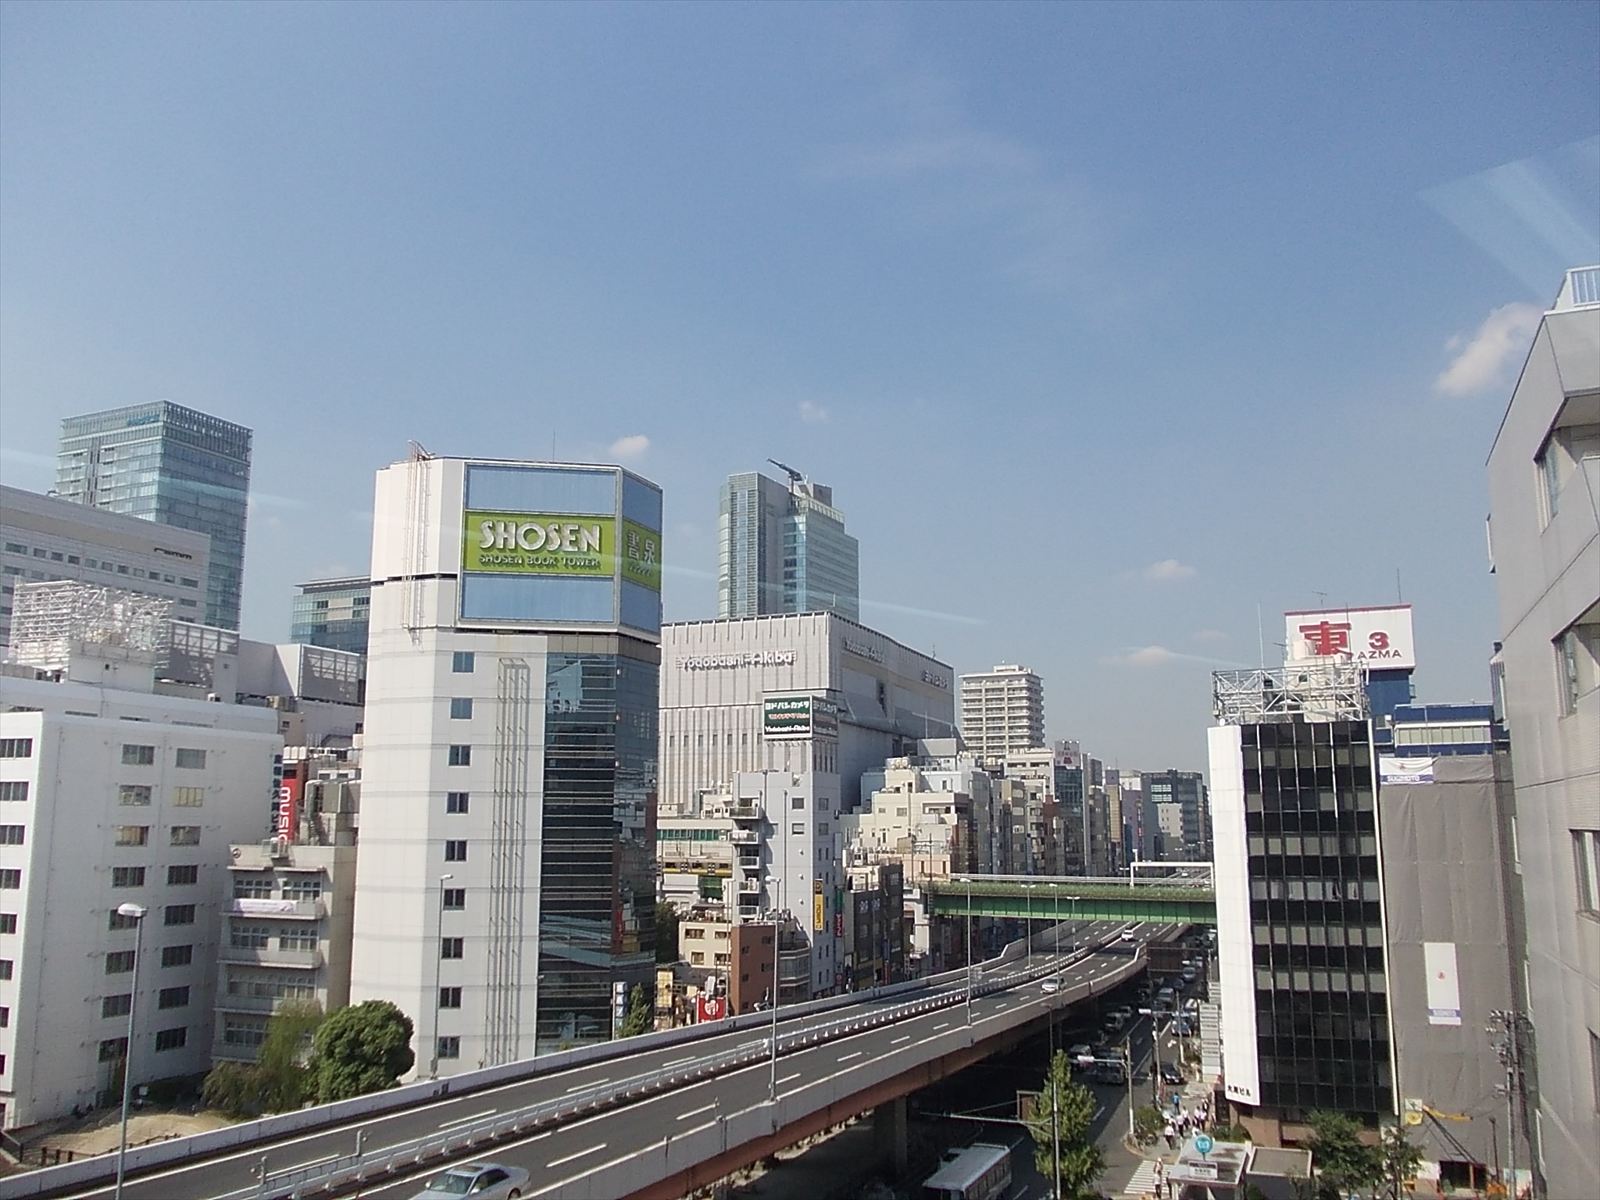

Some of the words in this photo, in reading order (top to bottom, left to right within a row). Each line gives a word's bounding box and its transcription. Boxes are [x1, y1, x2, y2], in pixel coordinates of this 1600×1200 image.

[480, 520, 601, 552] SHOSEN
[480, 554, 523, 565] SHOSEN
[527, 555, 557, 566] BOOK
[561, 556, 600, 567] TOWER
[1299, 620, 1353, 661] 東
[1368, 631, 1390, 650] 3
[1357, 649, 1402, 660] AZMA
